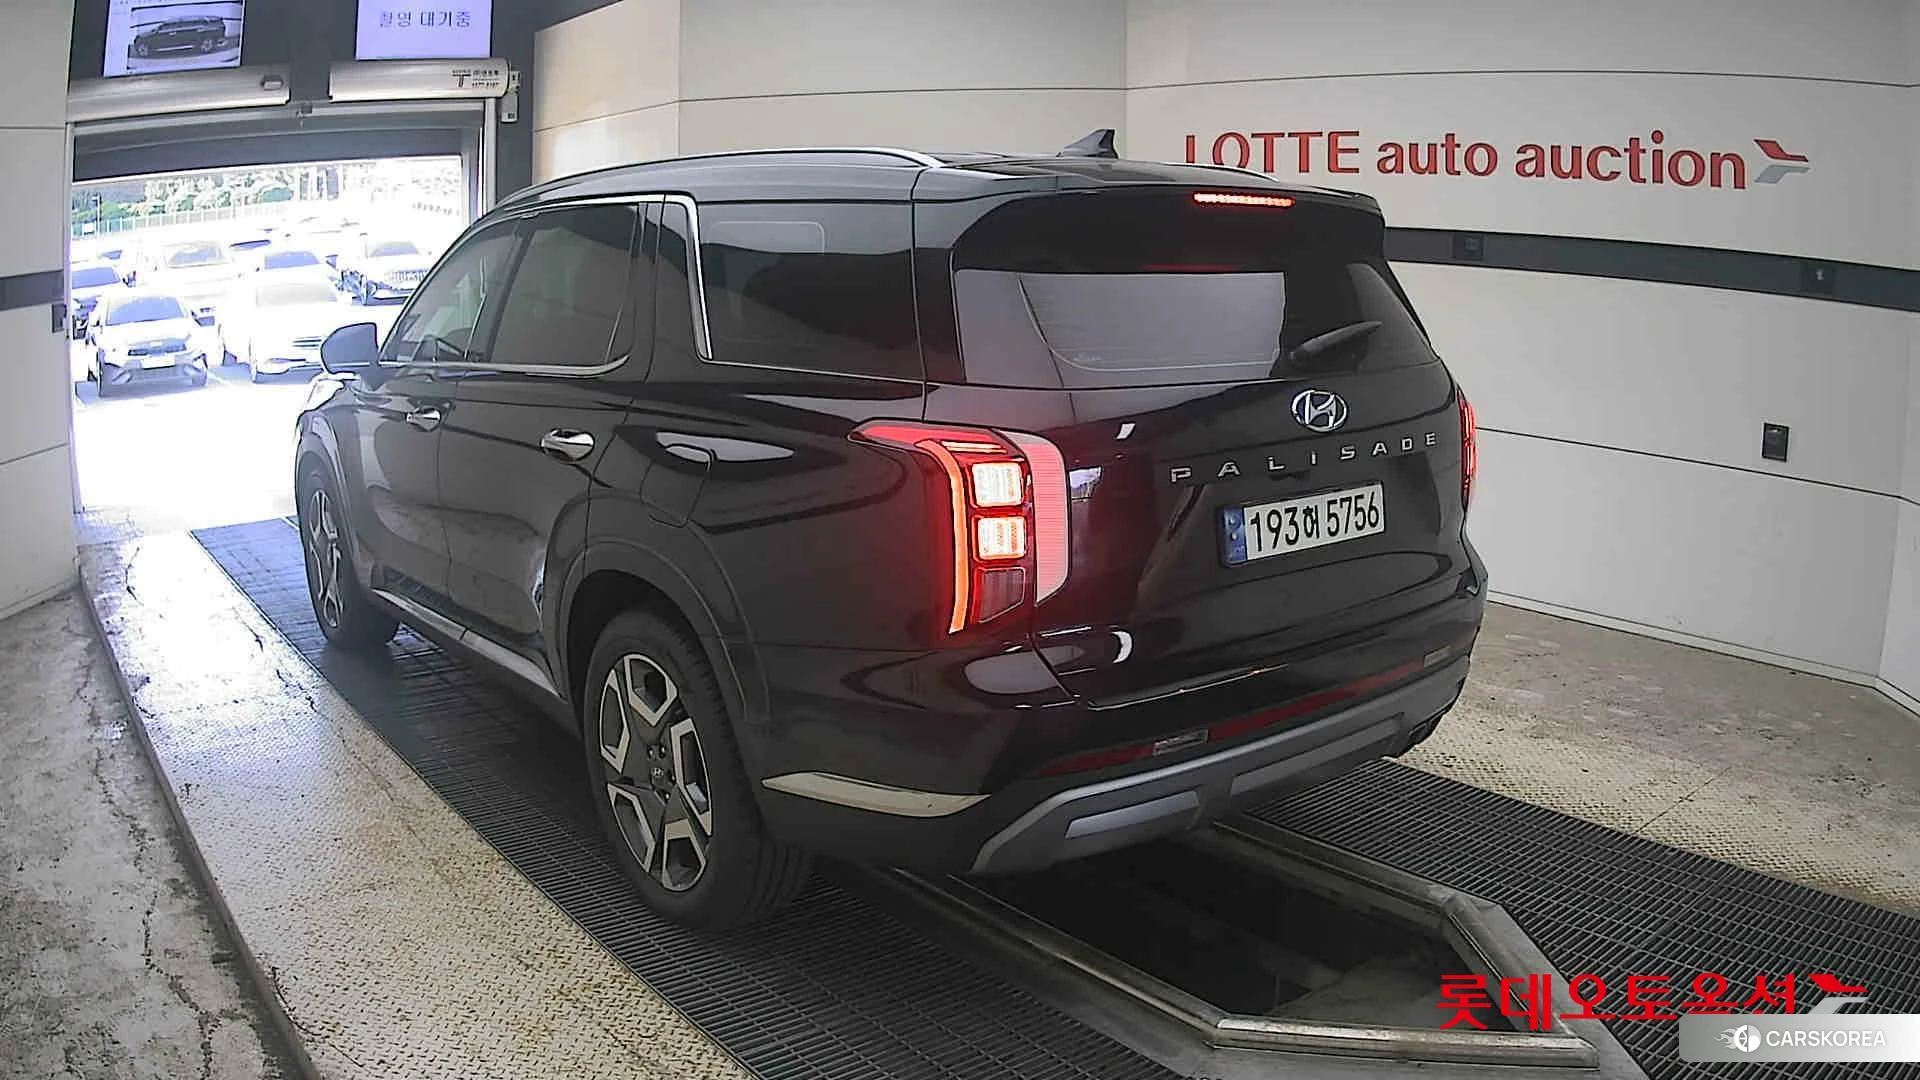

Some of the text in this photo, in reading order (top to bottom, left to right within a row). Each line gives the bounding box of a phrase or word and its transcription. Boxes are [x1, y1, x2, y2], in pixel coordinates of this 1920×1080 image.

[420, 11, 471, 28] 대기중
[1185, 130, 1747, 190] LOTTE auto auction
[1169, 432, 1438, 483] PALISADE
[1250, 491, 1380, 552] 193허 5756
